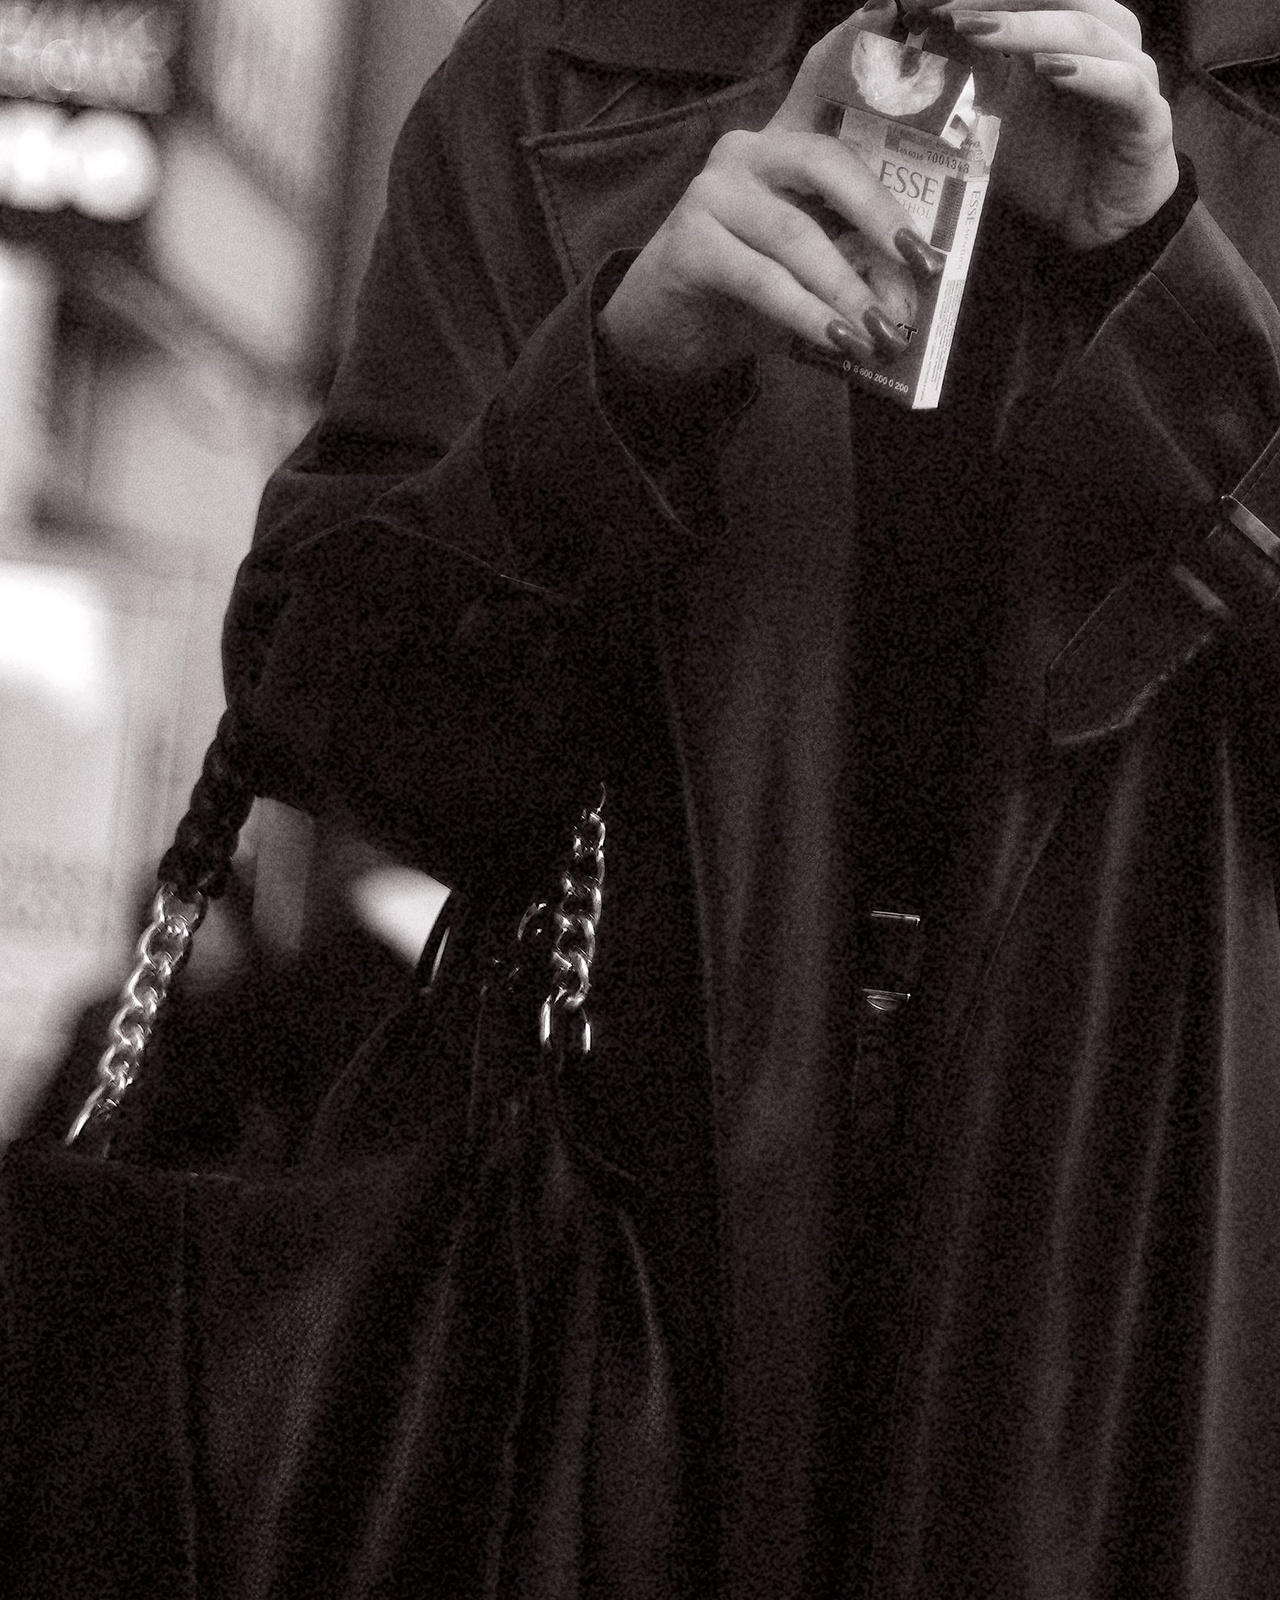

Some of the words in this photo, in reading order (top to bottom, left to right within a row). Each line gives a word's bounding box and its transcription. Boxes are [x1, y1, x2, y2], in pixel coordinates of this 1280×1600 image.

[879, 160, 938, 206] ESSE
[902, 201, 930, 219] THOL
[965, 190, 981, 226] ESSE
[860, 367, 873, 379] 800
[874, 373, 888, 385] 200
[888, 379, 894, 388] 0
[894, 381, 909, 393] 200
